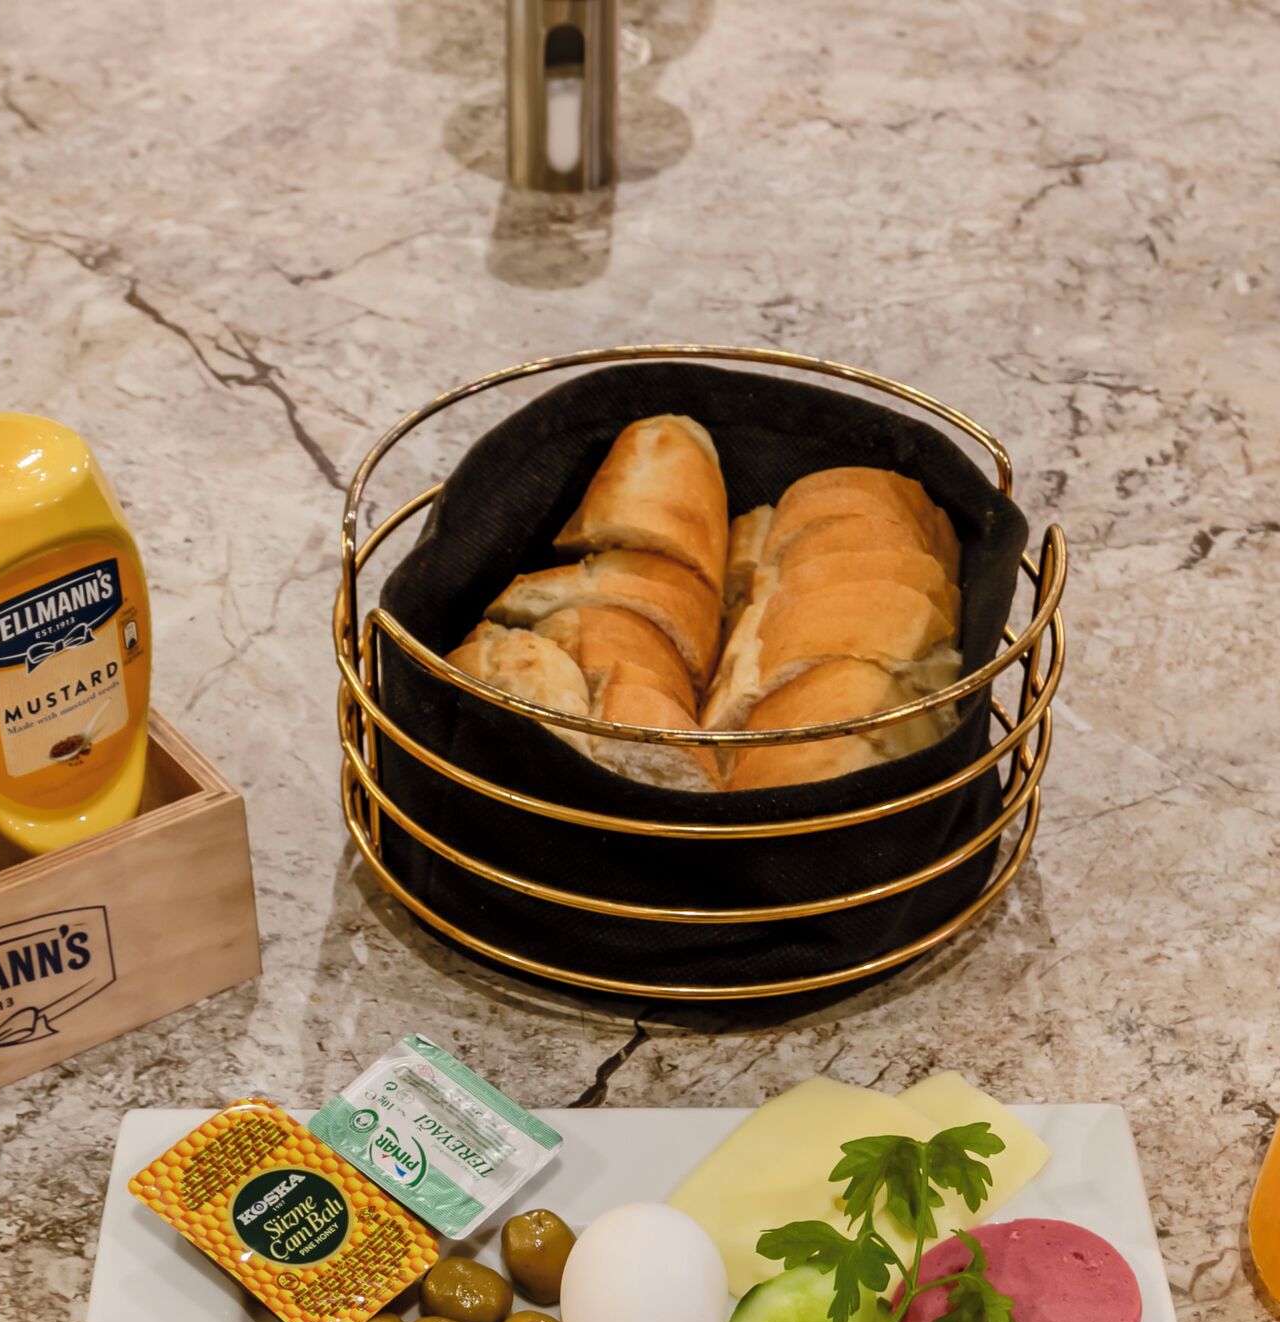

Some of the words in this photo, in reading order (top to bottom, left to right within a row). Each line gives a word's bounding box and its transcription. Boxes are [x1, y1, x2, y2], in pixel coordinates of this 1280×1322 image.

[5, 661, 119, 724] MUSTARD
[60, 692, 97, 716] mustard
[413, 1114, 496, 1178] TEREYAĞI
[236, 1173, 306, 1226] KOSKA
[263, 1195, 317, 1240] Süzme
[270, 1226, 313, 1261] Çam
[305, 1198, 344, 1233] Balı
[299, 1241, 317, 1257] PINE
[314, 1222, 339, 1245] HONEY
